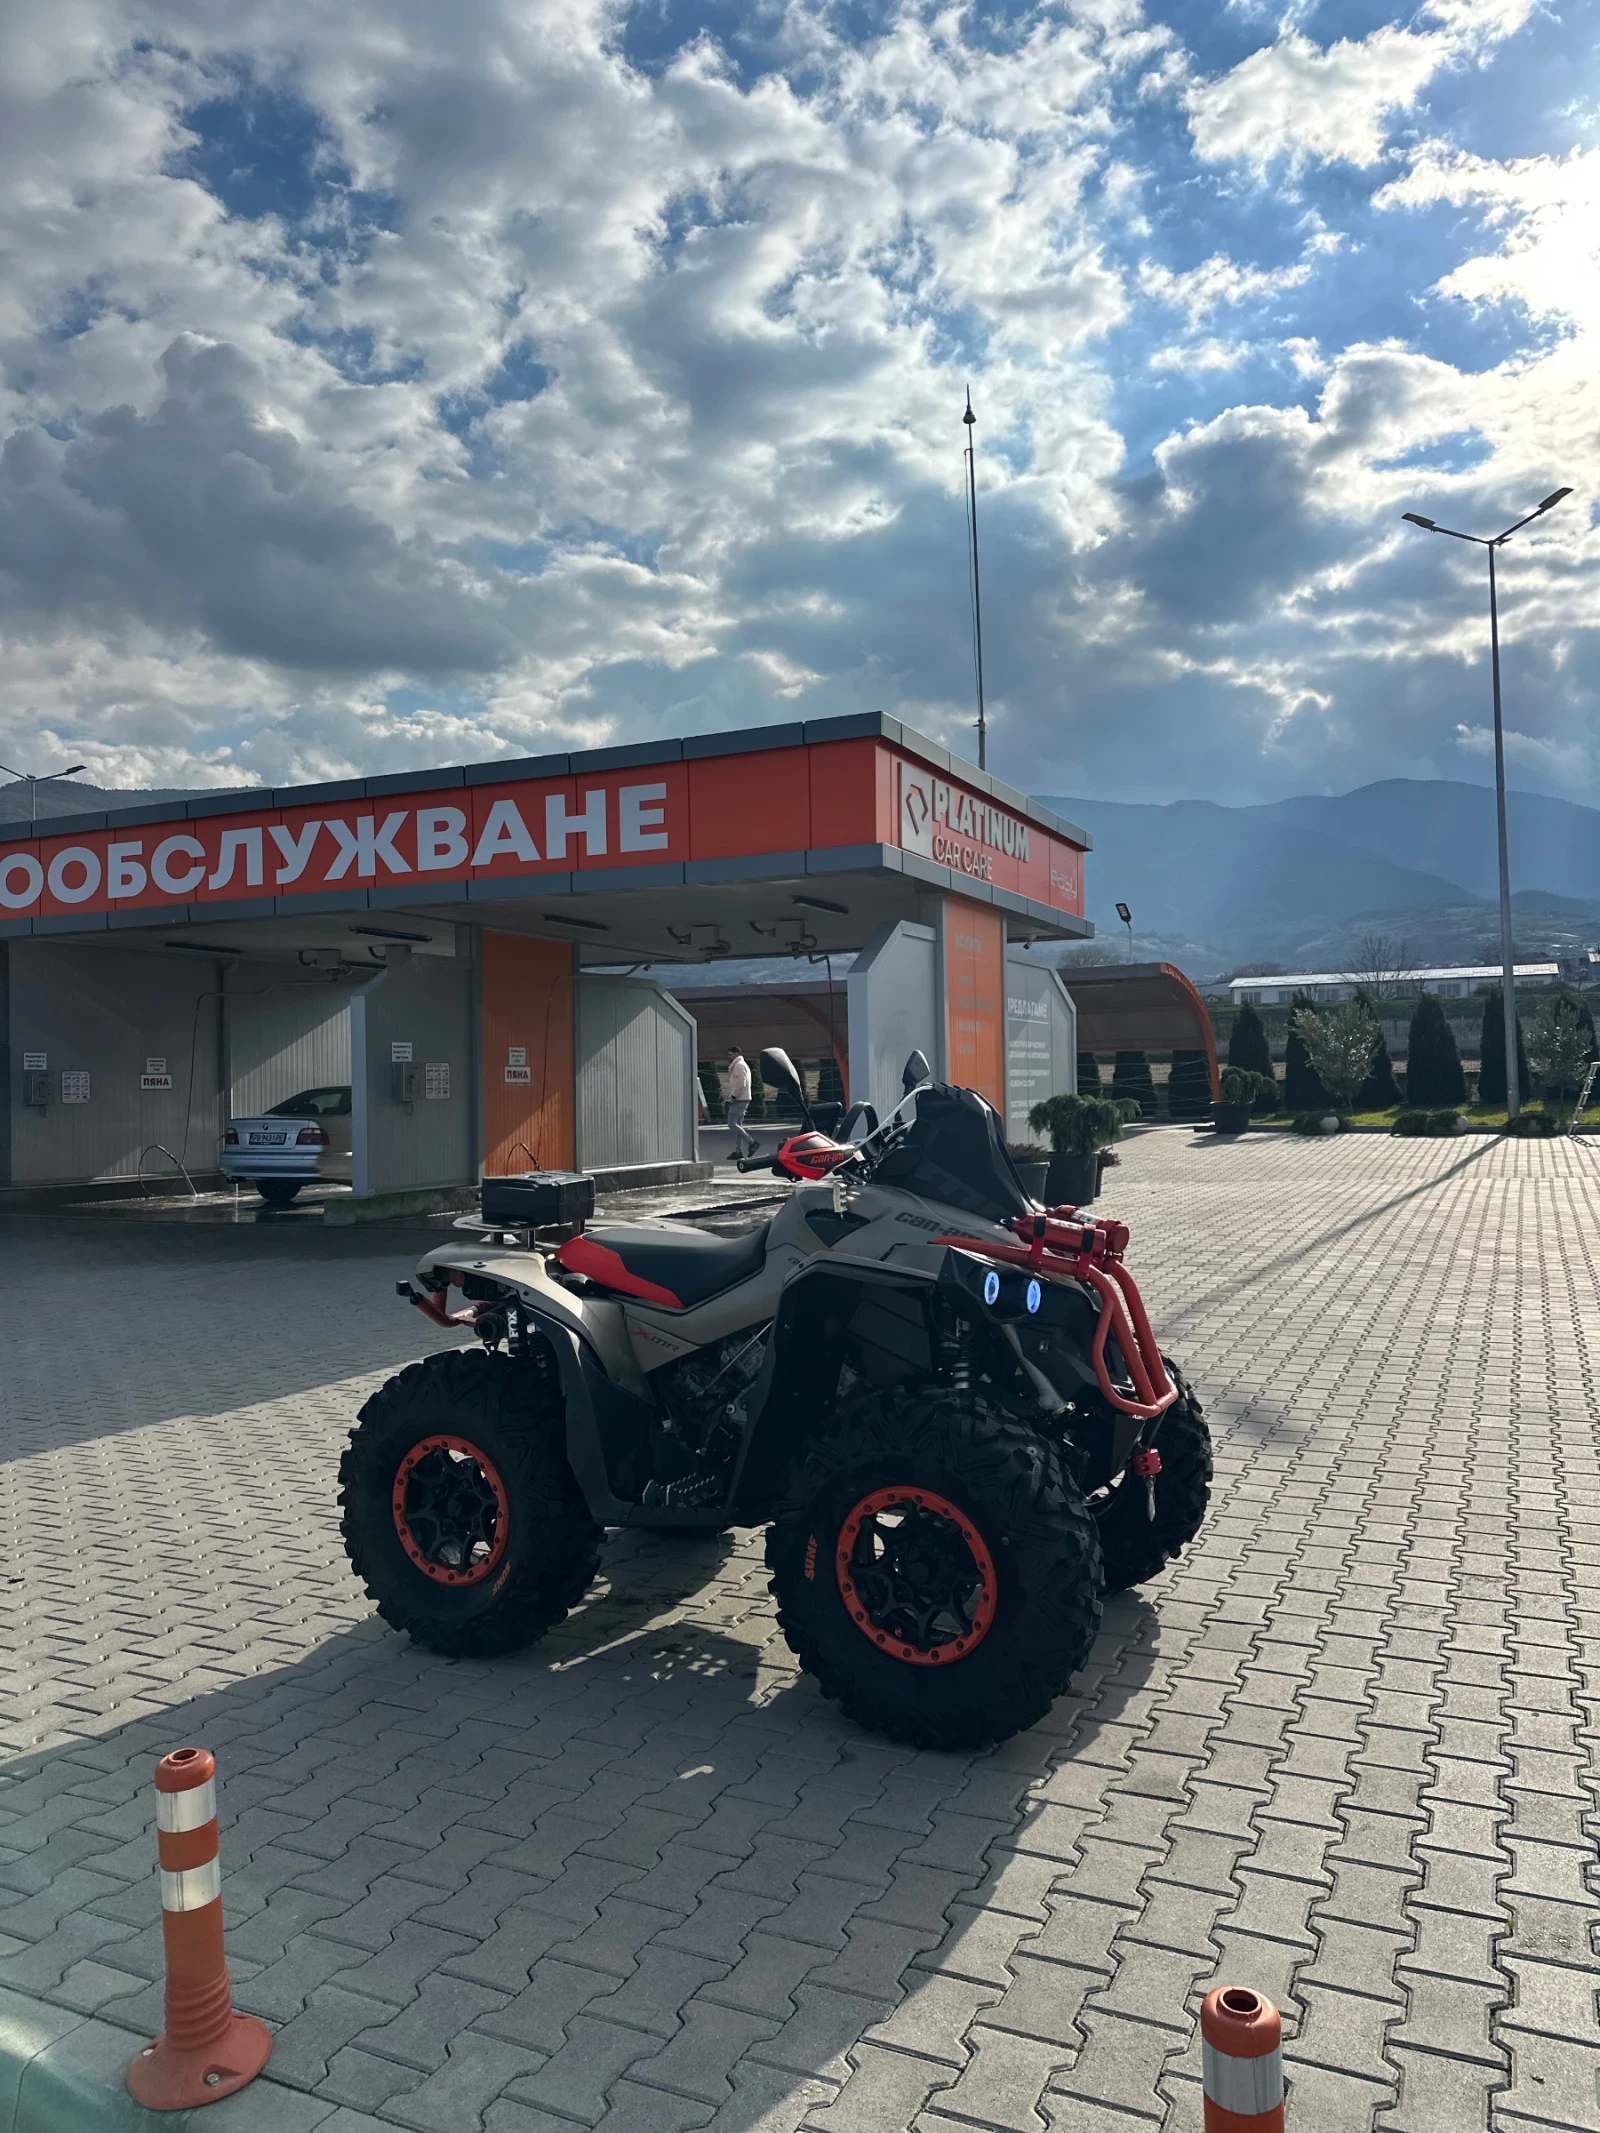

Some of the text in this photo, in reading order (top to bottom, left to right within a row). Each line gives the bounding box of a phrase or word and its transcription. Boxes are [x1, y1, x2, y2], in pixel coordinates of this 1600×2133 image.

[933, 780, 1030, 863] PLATINUM
[0, 782, 669, 910] ООБСЛУЖВАНЕ
[934, 835, 993, 881] CAR CARE
[1050, 868, 1078, 899] easy
[143, 1077, 170, 1086] ПЯНА
[506, 1070, 529, 1080] ПЯНА
[810, 1153, 844, 1164] can-am
[507, 1310, 519, 1338] FOX
